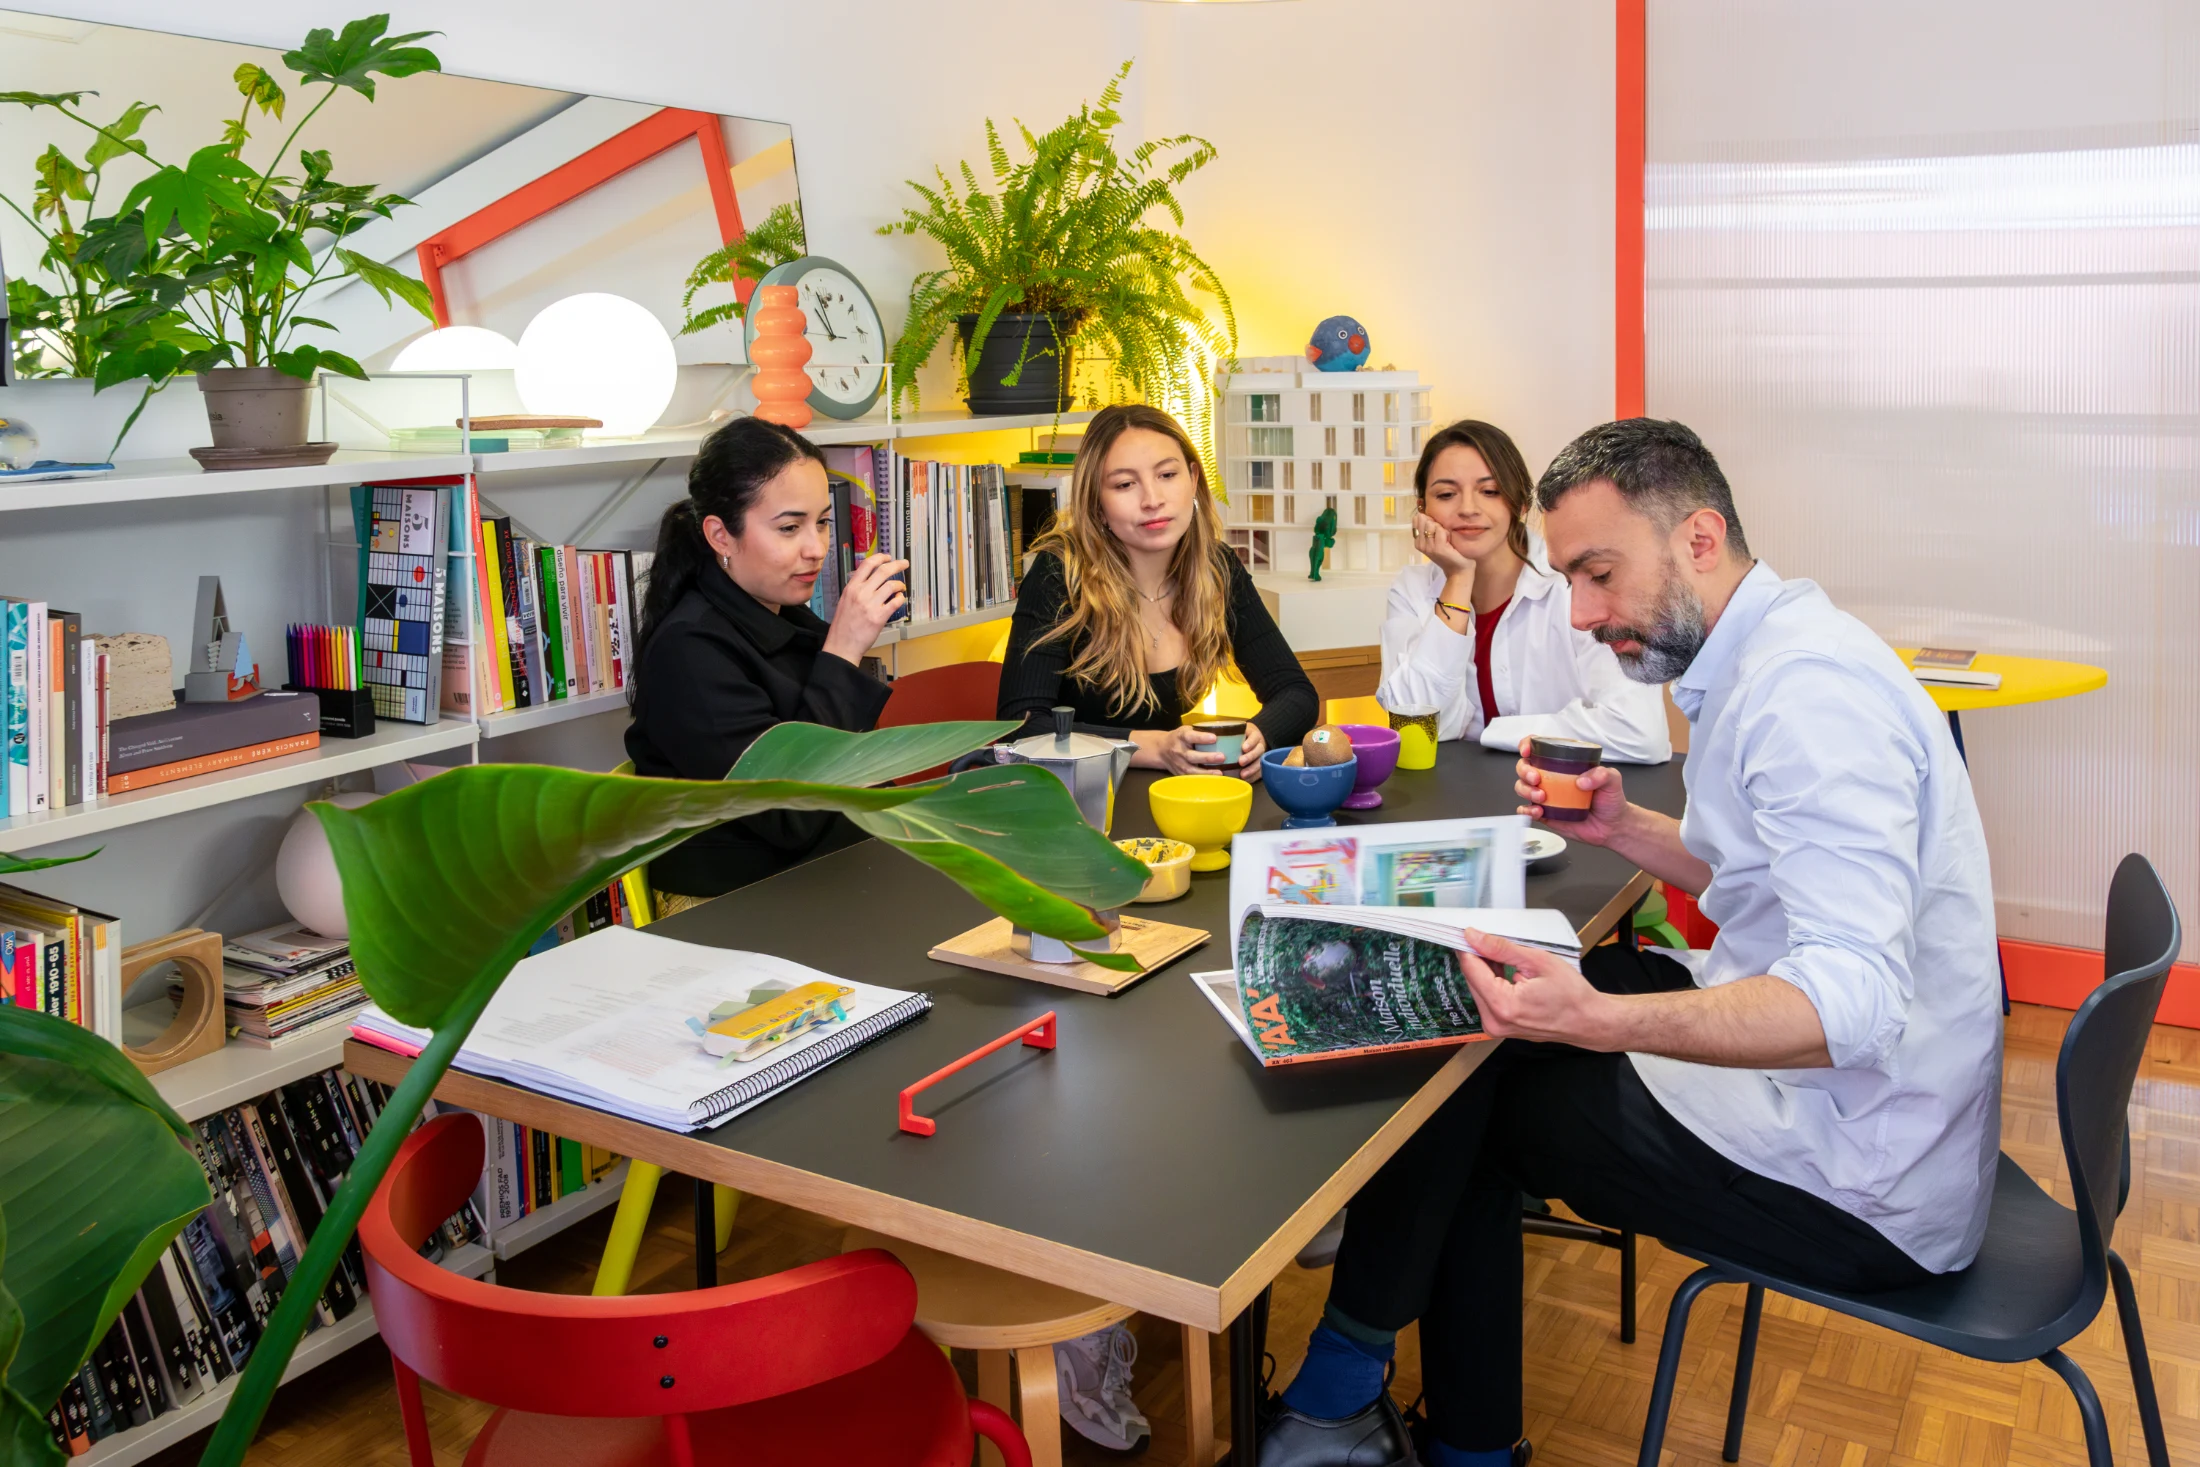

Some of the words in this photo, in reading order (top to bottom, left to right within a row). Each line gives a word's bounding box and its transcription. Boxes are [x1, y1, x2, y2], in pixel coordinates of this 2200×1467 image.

[403, 494, 412, 548] MAISONS
[412, 513, 428, 531] 5
[504, 530, 510, 538] XX
[435, 568, 446, 578] 5
[556, 550, 566, 578] diseño
[557, 580, 566, 600] para
[432, 583, 445, 654] MAISONS
[251, 747, 272, 758] KÉRÉ
[276, 739, 310, 752] FRANCIS
[160, 763, 203, 776] ELEMENTS
[208, 754, 243, 767] PRIMARY
[49, 946, 60, 994] 1910-65
[1383, 942, 1425, 1031] individuelle
[1434, 976, 1452, 1010] House
[1369, 980, 1401, 1033] Maison
[1450, 1012, 1464, 1026] The
